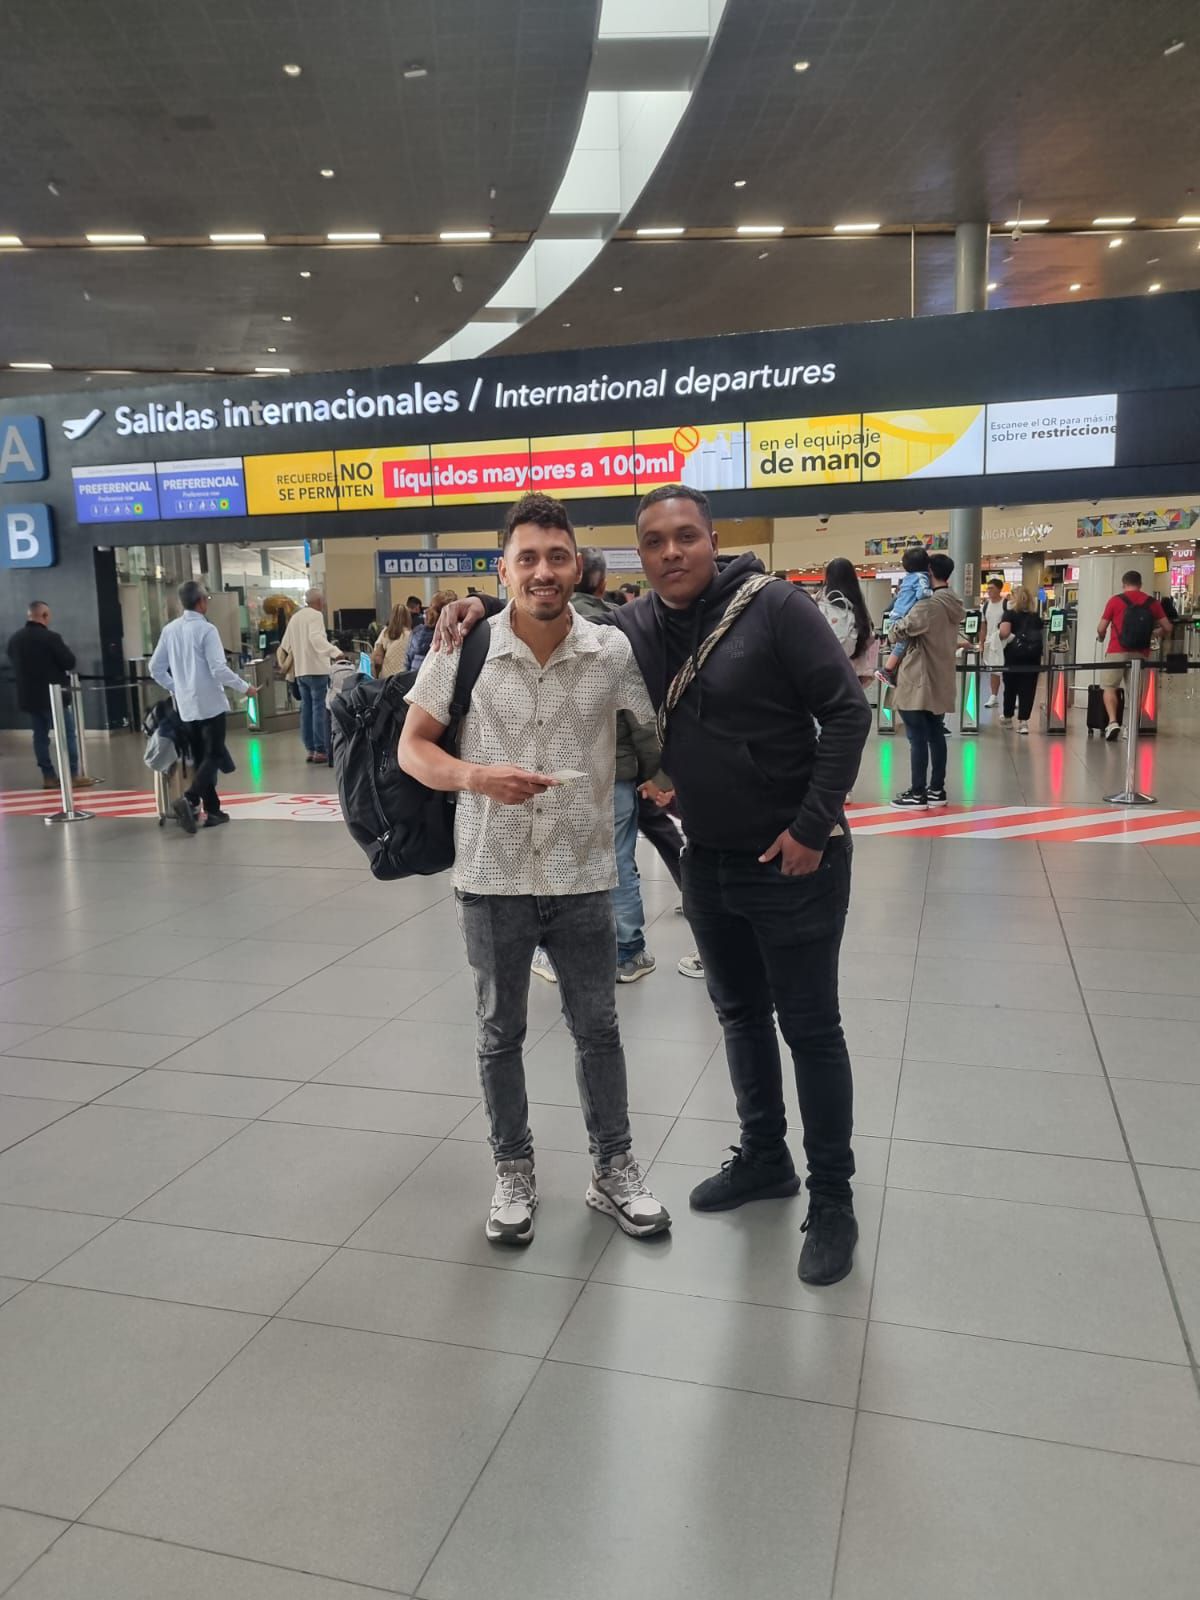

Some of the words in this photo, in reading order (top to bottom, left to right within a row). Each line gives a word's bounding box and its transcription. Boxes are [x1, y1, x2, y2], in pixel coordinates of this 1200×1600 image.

[115, 400, 216, 436] Salidas
[223, 382, 460, 427] internacionales
[468, 378, 483, 412] /
[495, 369, 667, 408] International
[674, 363, 837, 401] departures
[991, 421, 1028, 430] Escanee
[1031, 419, 1040, 427] el
[1042, 417, 1057, 427] QR
[1060, 417, 1081, 426] para
[1083, 414, 1103, 424] más
[759, 440, 779, 452] en
[784, 433, 798, 449] el
[803, 428, 881, 450] equipaje
[992, 431, 1027, 442] sobre
[0, 425, 35, 474] A
[340, 462, 373, 482] NO
[393, 464, 478, 492] líquidos
[483, 464, 576, 487] mayores
[580, 464, 595, 478] a
[599, 450, 675, 476] 100ml
[760, 452, 793, 474] de
[801, 451, 881, 473] mano
[79, 481, 153, 495] PREFERENCIAL
[163, 476, 239, 491] PREFERENCIAL
[279, 488, 295, 501] SE
[298, 484, 374, 500] PERMITEN
[1137, 517, 1157, 527] Viaje
[7, 512, 39, 560] B
